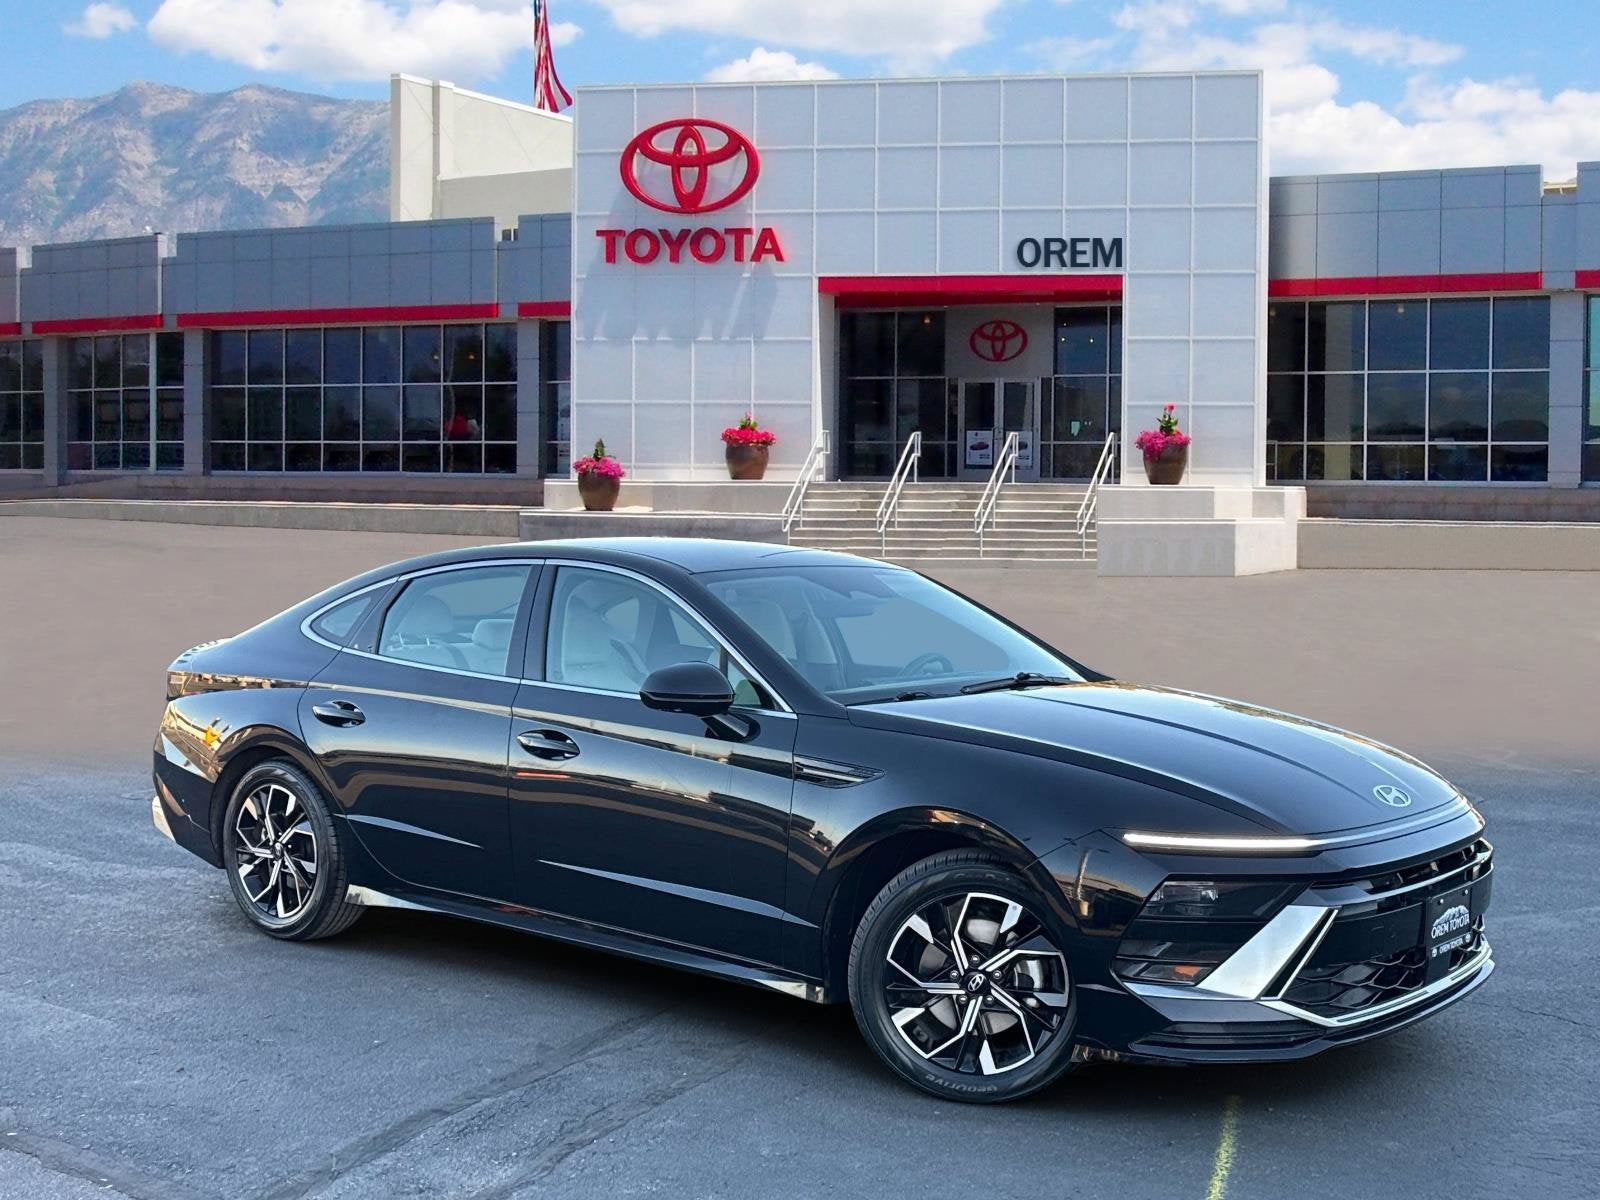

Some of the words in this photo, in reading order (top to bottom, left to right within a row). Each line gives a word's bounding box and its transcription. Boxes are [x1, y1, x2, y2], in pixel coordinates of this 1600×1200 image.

[595, 227, 785, 264] TOYOTA
[1016, 237, 1123, 268] OREM
[1431, 922, 1449, 938] OREM
[1450, 914, 1469, 931] TOYOTA
[1439, 943, 1450, 954] OREM
